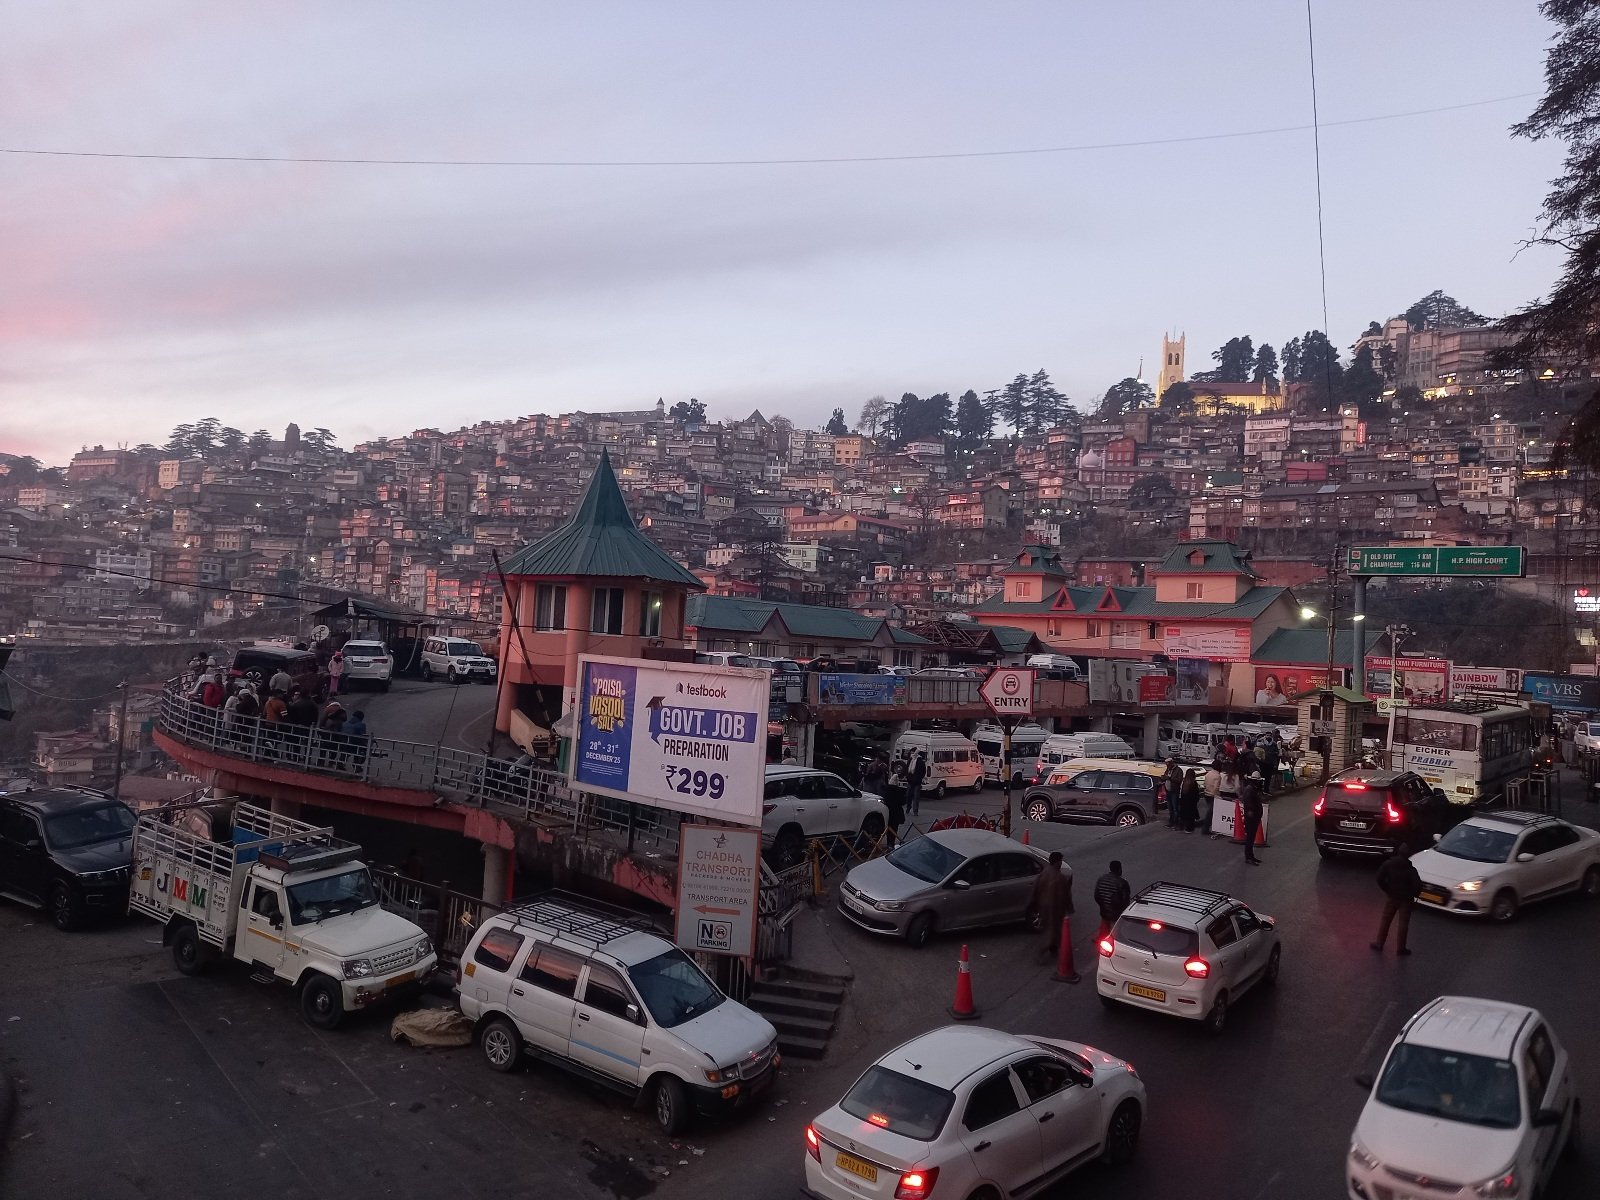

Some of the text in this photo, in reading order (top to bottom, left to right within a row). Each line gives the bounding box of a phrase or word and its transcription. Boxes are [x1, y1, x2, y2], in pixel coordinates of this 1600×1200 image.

[1373, 658, 1446, 669] MAHAAXMI FURNITURE
[596, 678, 622, 697] PAISA
[686, 683, 727, 698] testbook
[1552, 683, 1582, 696] VRS
[589, 695, 625, 719] VASOOL
[994, 697, 1029, 707] ENTRY
[597, 715, 615, 731] SALE
[659, 708, 746, 739] GOVT. JOB
[663, 739, 729, 761] PREPARATION
[1415, 747, 1451, 756] EICHER
[696, 850, 743, 863] CHADHA
[686, 862, 753, 877] TRANSPORT
[687, 893, 748, 905] TRANSPORT AREA
[700, 939, 728, 948] PARKING
